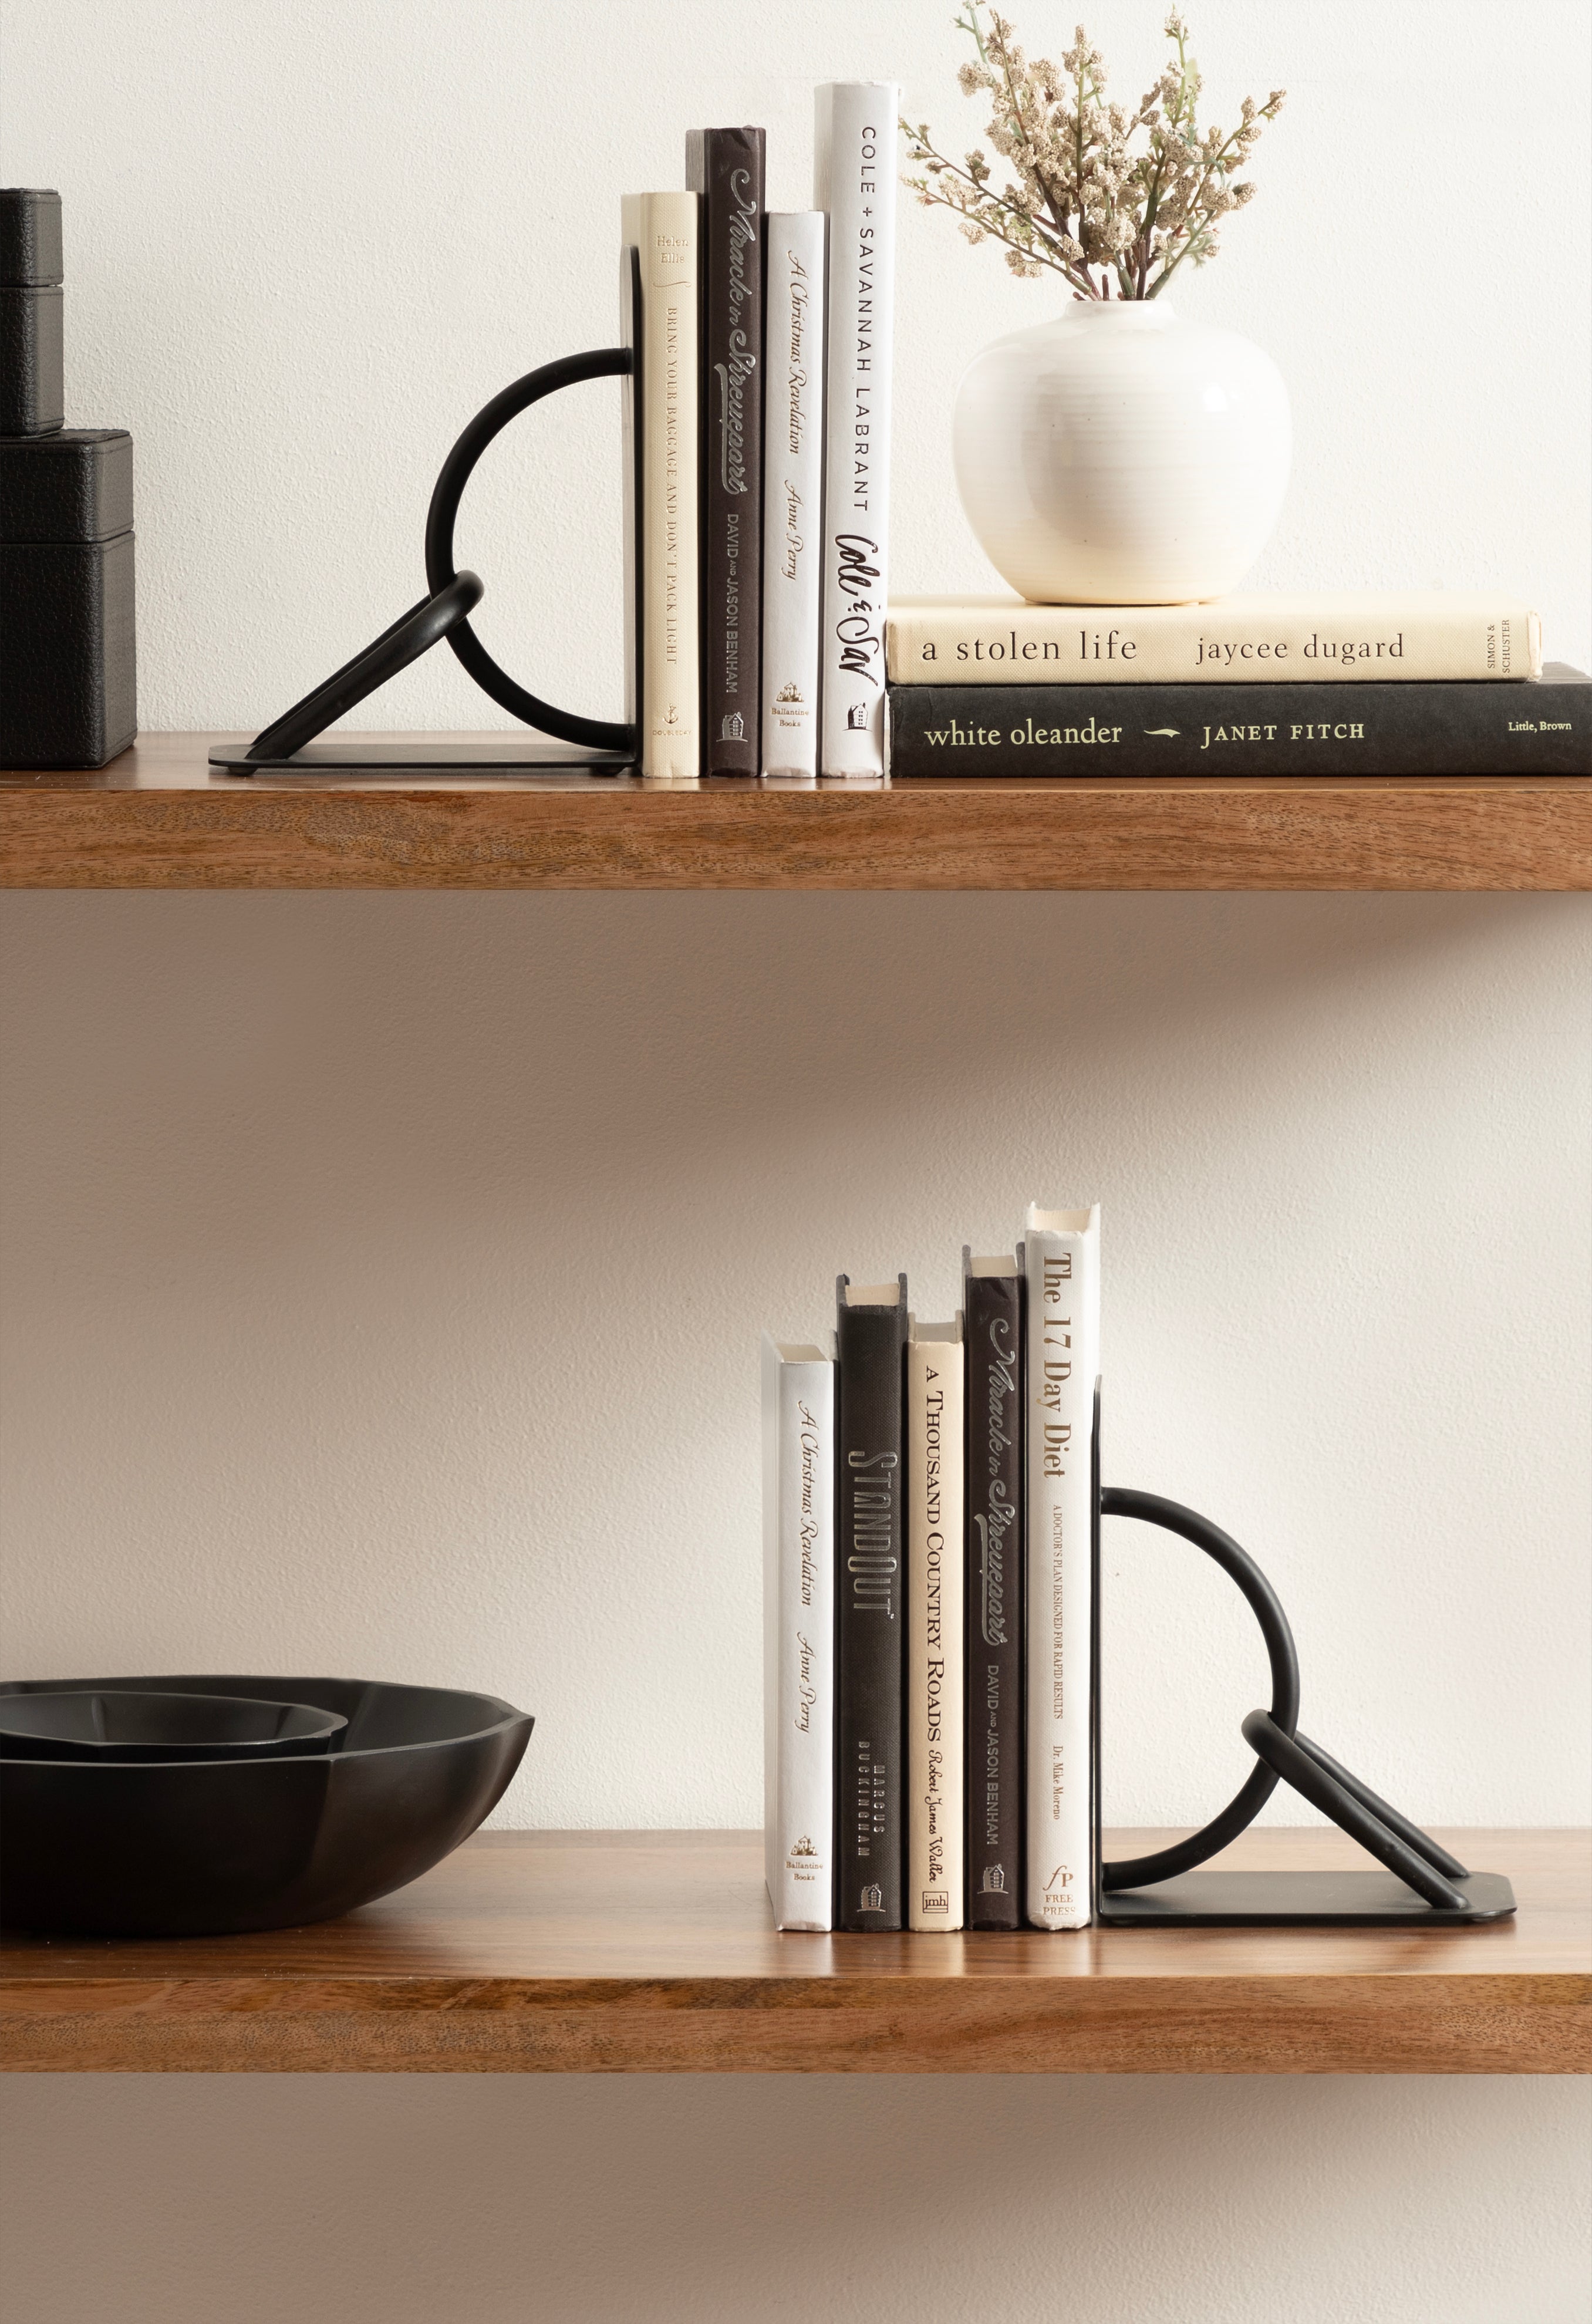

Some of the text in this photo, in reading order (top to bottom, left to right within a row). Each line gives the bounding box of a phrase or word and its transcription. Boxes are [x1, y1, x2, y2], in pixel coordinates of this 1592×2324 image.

[657, 235, 689, 247] Helen
[661, 252, 685, 264] Ellis
[714, 168, 757, 495] Miracle in Shreveport
[854, 127, 876, 511] COLE + SAVANNAH LABRANT
[788, 250, 809, 455] A Christmas Revelation
[666, 308, 677, 665] BRING YOUR BAGGAGE AND DON'T PACK LIGHT
[727, 513, 739, 558] DAVID
[781, 479, 804, 581] Anne Perry
[835, 534, 881, 596] Cole
[727, 577, 738, 626] JASON
[726, 630, 738, 693] BENHAM
[836, 616, 880, 686] Sav
[922, 630, 1137, 660] a stolen life
[1195, 633, 1405, 666] jaycee dugard
[1487, 635, 1495, 669] SIMON
[1502, 619, 1510, 673] SCHUSTER
[771, 707, 809, 716] Ballantine
[923, 717, 1122, 746] white oleander
[1508, 720, 1572, 733] Little, Brown
[1200, 723, 1365, 750] JANET FITCH
[1036, 1252, 1072, 1478] The 17 Day Diet
[798, 1400, 820, 1607] A Christmas Revelation
[974, 1317, 1016, 1646] Miracle in Shreveport
[926, 1365, 944, 1742] A THOUSAND COUNTRY ROADS
[1053, 1513, 1063, 1557] DOCTOR'S
[1053, 1559, 1063, 1583] PLAN
[1053, 1584, 1063, 1630] DESIGNED
[1054, 1631, 1063, 1650] FOR
[794, 1631, 817, 1735] Anne Perry
[987, 1665, 999, 1709] DAVID
[1054, 1651, 1063, 1679] RAPID
[1054, 1681, 1063, 1720] RESULTS
[987, 1729, 999, 1778] JASON
[858, 1741, 870, 1856] BUCKINGHAM
[873, 1765, 885, 1833] MARCUS
[1053, 1745, 1064, 1820] Dr. Mike Moreno
[924, 1749, 943, 1884] Robert James Waller
[987, 1782, 999, 1845] BENHAM
[785, 1861, 823, 1869] Ballantine
[925, 1895, 946, 1909] jmh
[1043, 1907, 1075, 1915] PRESS
[1045, 1894, 1074, 1903] FREE
